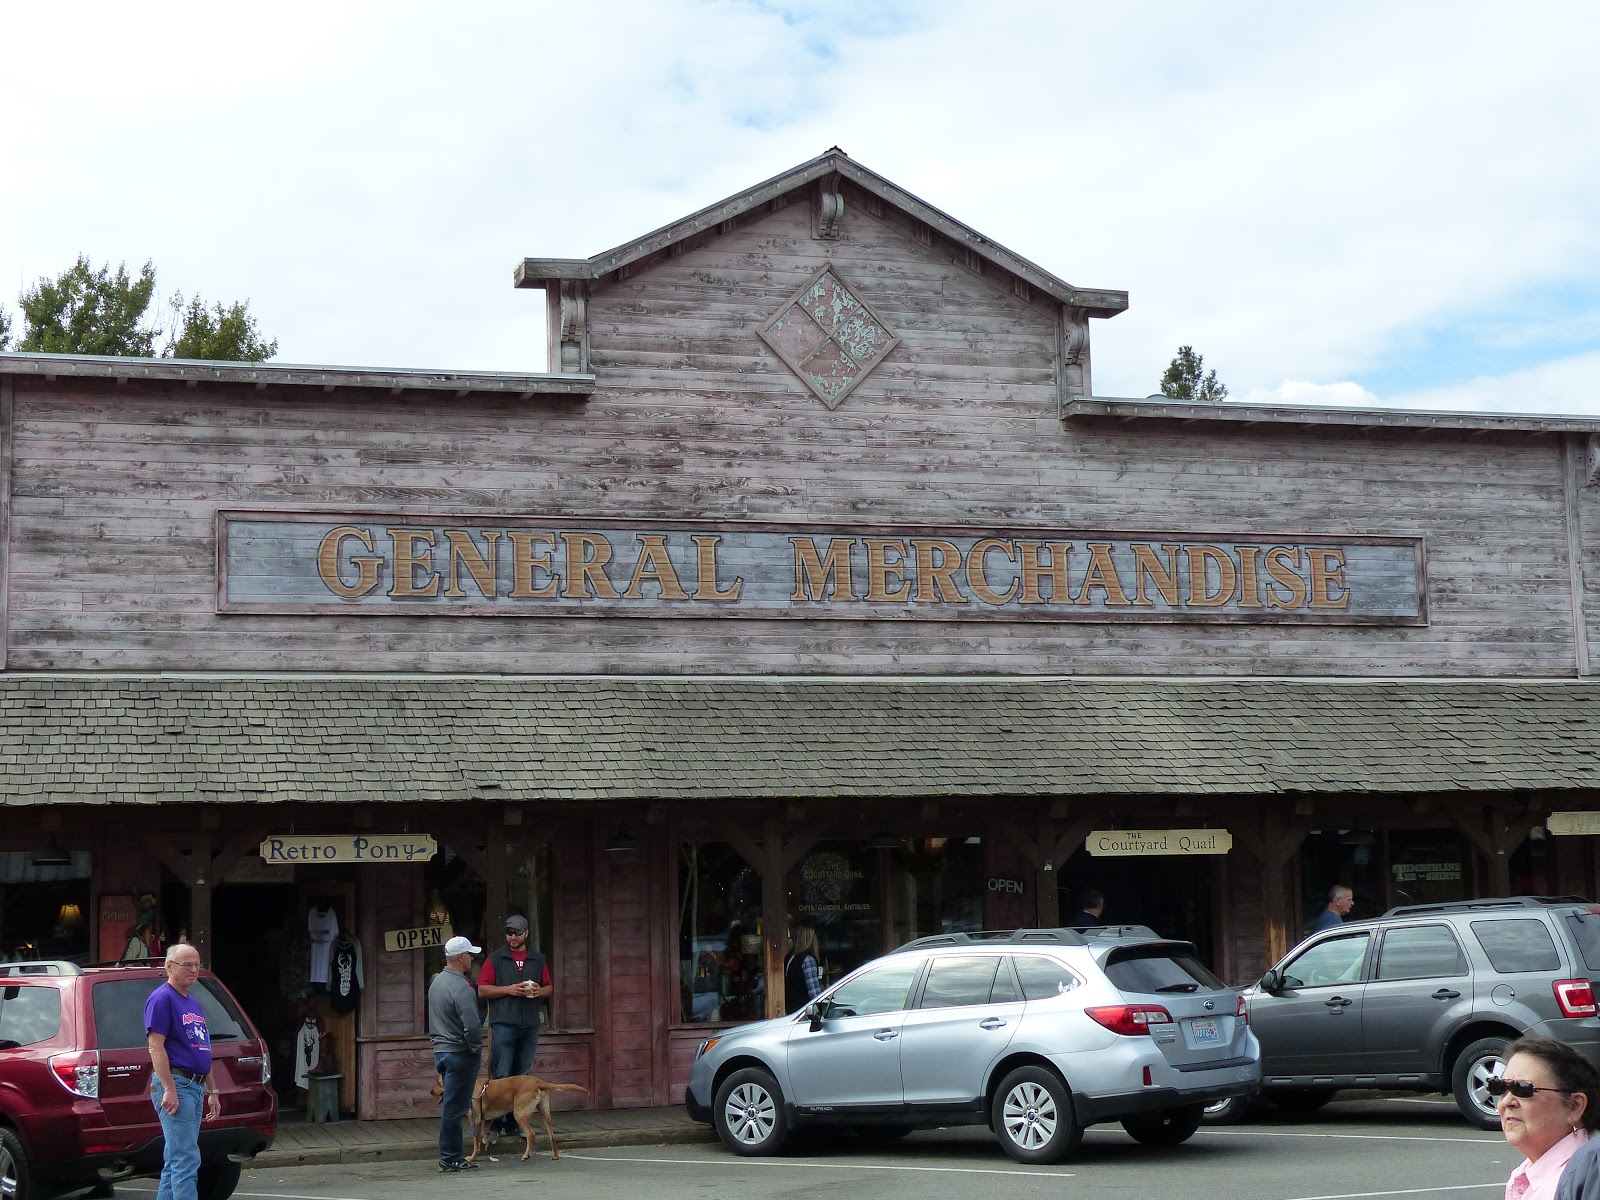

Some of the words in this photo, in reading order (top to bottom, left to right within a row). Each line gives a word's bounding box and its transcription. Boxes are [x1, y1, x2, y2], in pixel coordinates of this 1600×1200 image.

[315, 525, 744, 603] GENERAL
[788, 535, 1351, 612] MERCHANDISE
[269, 838, 337, 861] Retro
[353, 837, 426, 861] Pony
[1098, 836, 1168, 853] Courtyard
[1178, 835, 1216, 852] Quail
[988, 878, 1024, 894] OPEN
[396, 927, 442, 949] OPEN
[107, 1065, 141, 1073] SUBARU
